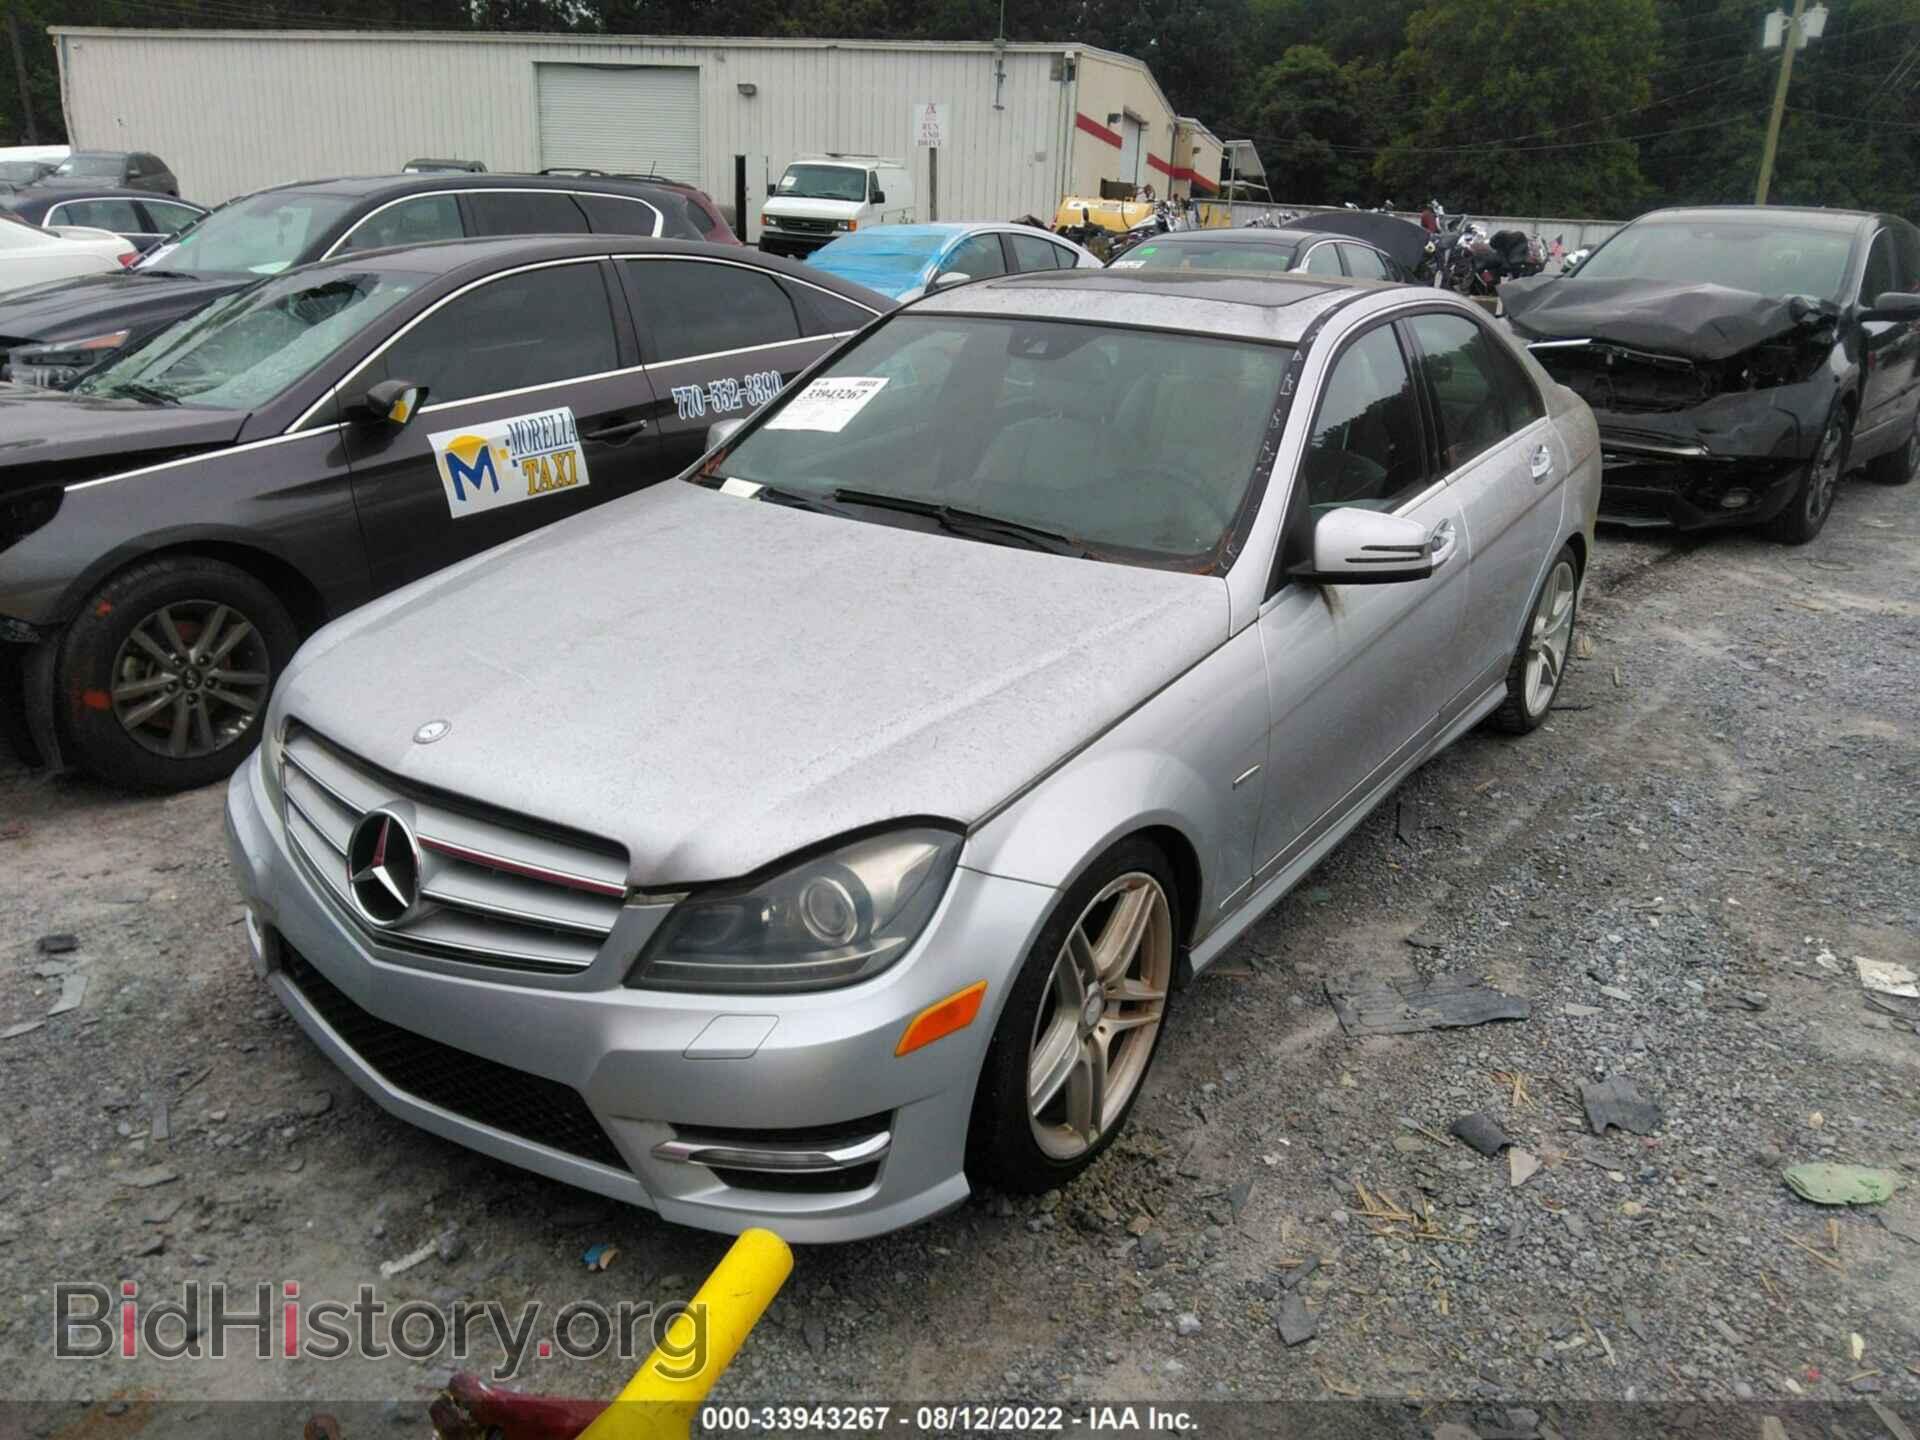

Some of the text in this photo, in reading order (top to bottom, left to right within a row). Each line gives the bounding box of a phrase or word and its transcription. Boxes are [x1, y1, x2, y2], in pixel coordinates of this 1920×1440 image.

[507, 412, 578, 456] MORELIA
[445, 445, 500, 501] M
[521, 449, 579, 496] TAXI
